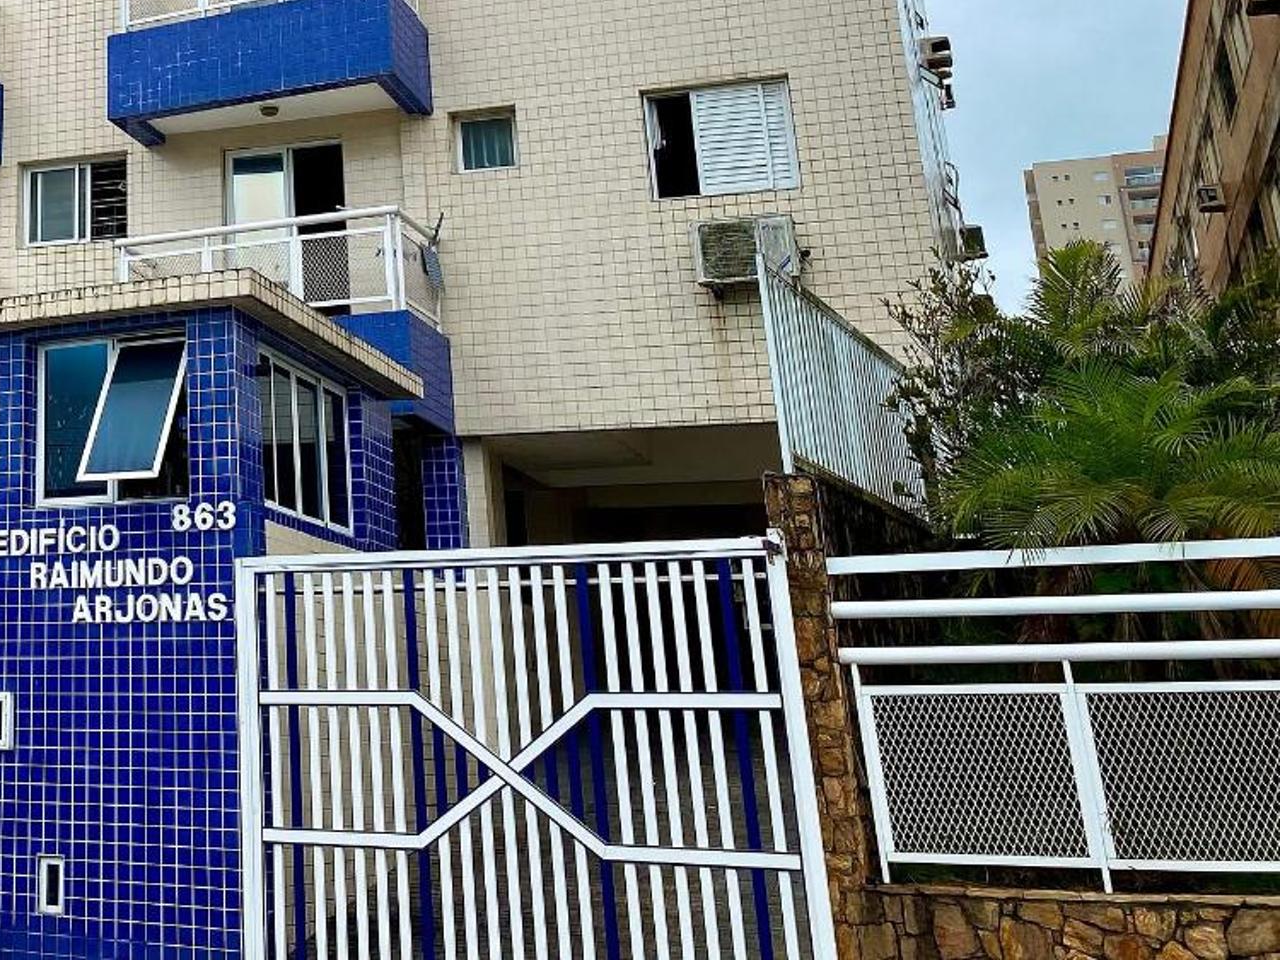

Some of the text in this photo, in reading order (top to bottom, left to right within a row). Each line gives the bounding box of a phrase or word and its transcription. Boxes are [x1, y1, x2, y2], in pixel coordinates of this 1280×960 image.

[172, 501, 236, 531] 863
[30, 556, 194, 589] RAIMUNDO
[72, 593, 228, 623] ARJONAS
